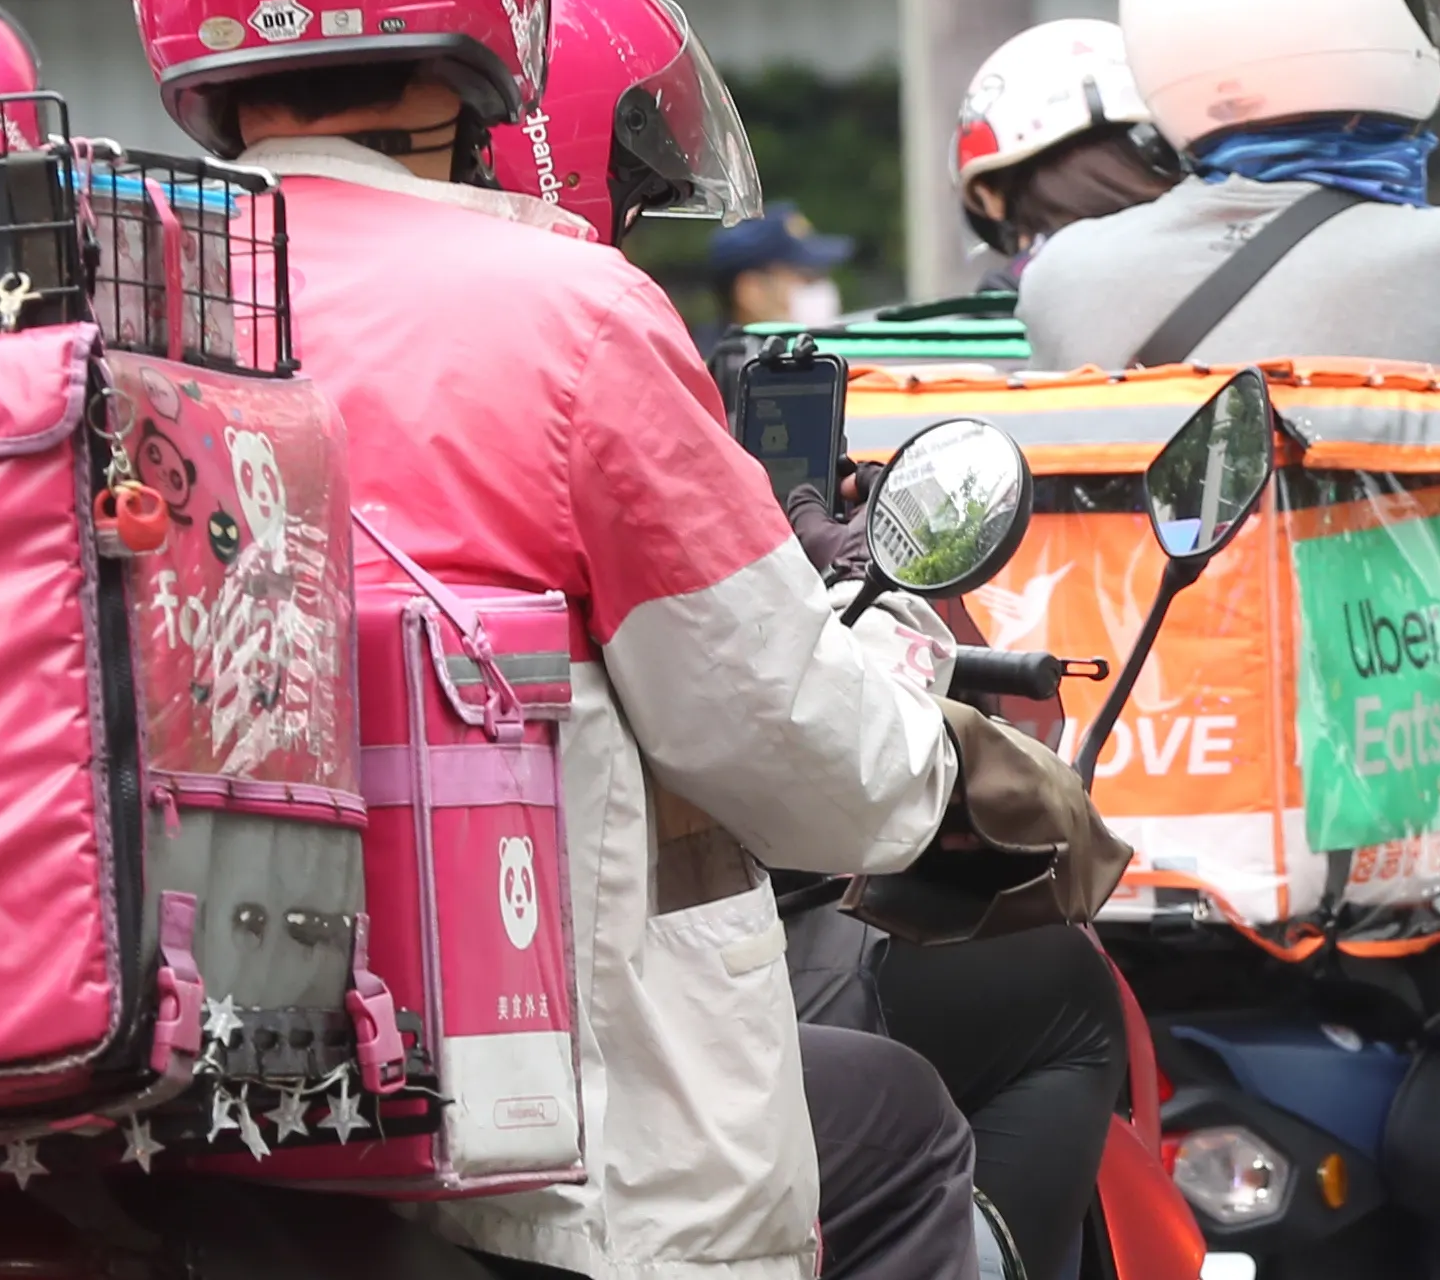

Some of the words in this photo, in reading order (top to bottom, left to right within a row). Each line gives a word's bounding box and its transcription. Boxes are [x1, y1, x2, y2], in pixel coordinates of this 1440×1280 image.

[263, 10, 297, 29] DOT
[1344, 597, 1440, 679] Uber
[498, 993, 549, 1020] 美食外送
